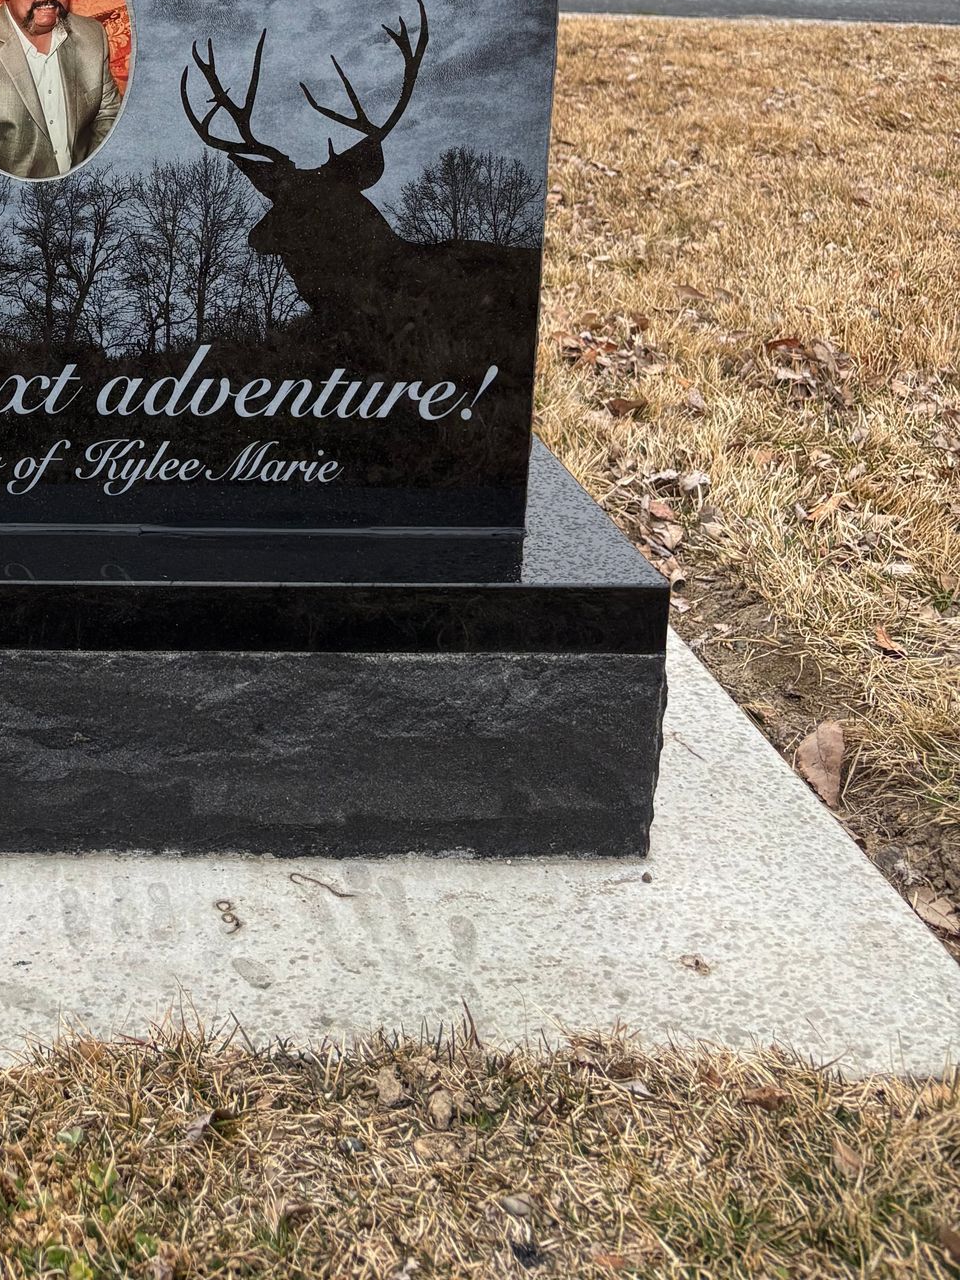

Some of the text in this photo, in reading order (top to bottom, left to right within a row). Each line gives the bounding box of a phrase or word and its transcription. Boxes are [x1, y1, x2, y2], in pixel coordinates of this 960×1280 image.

[96, 344, 499, 421] adventure!
[6, 439, 70, 496] of
[75, 439, 207, 497] Kylee
[205, 440, 344, 483] Marie
